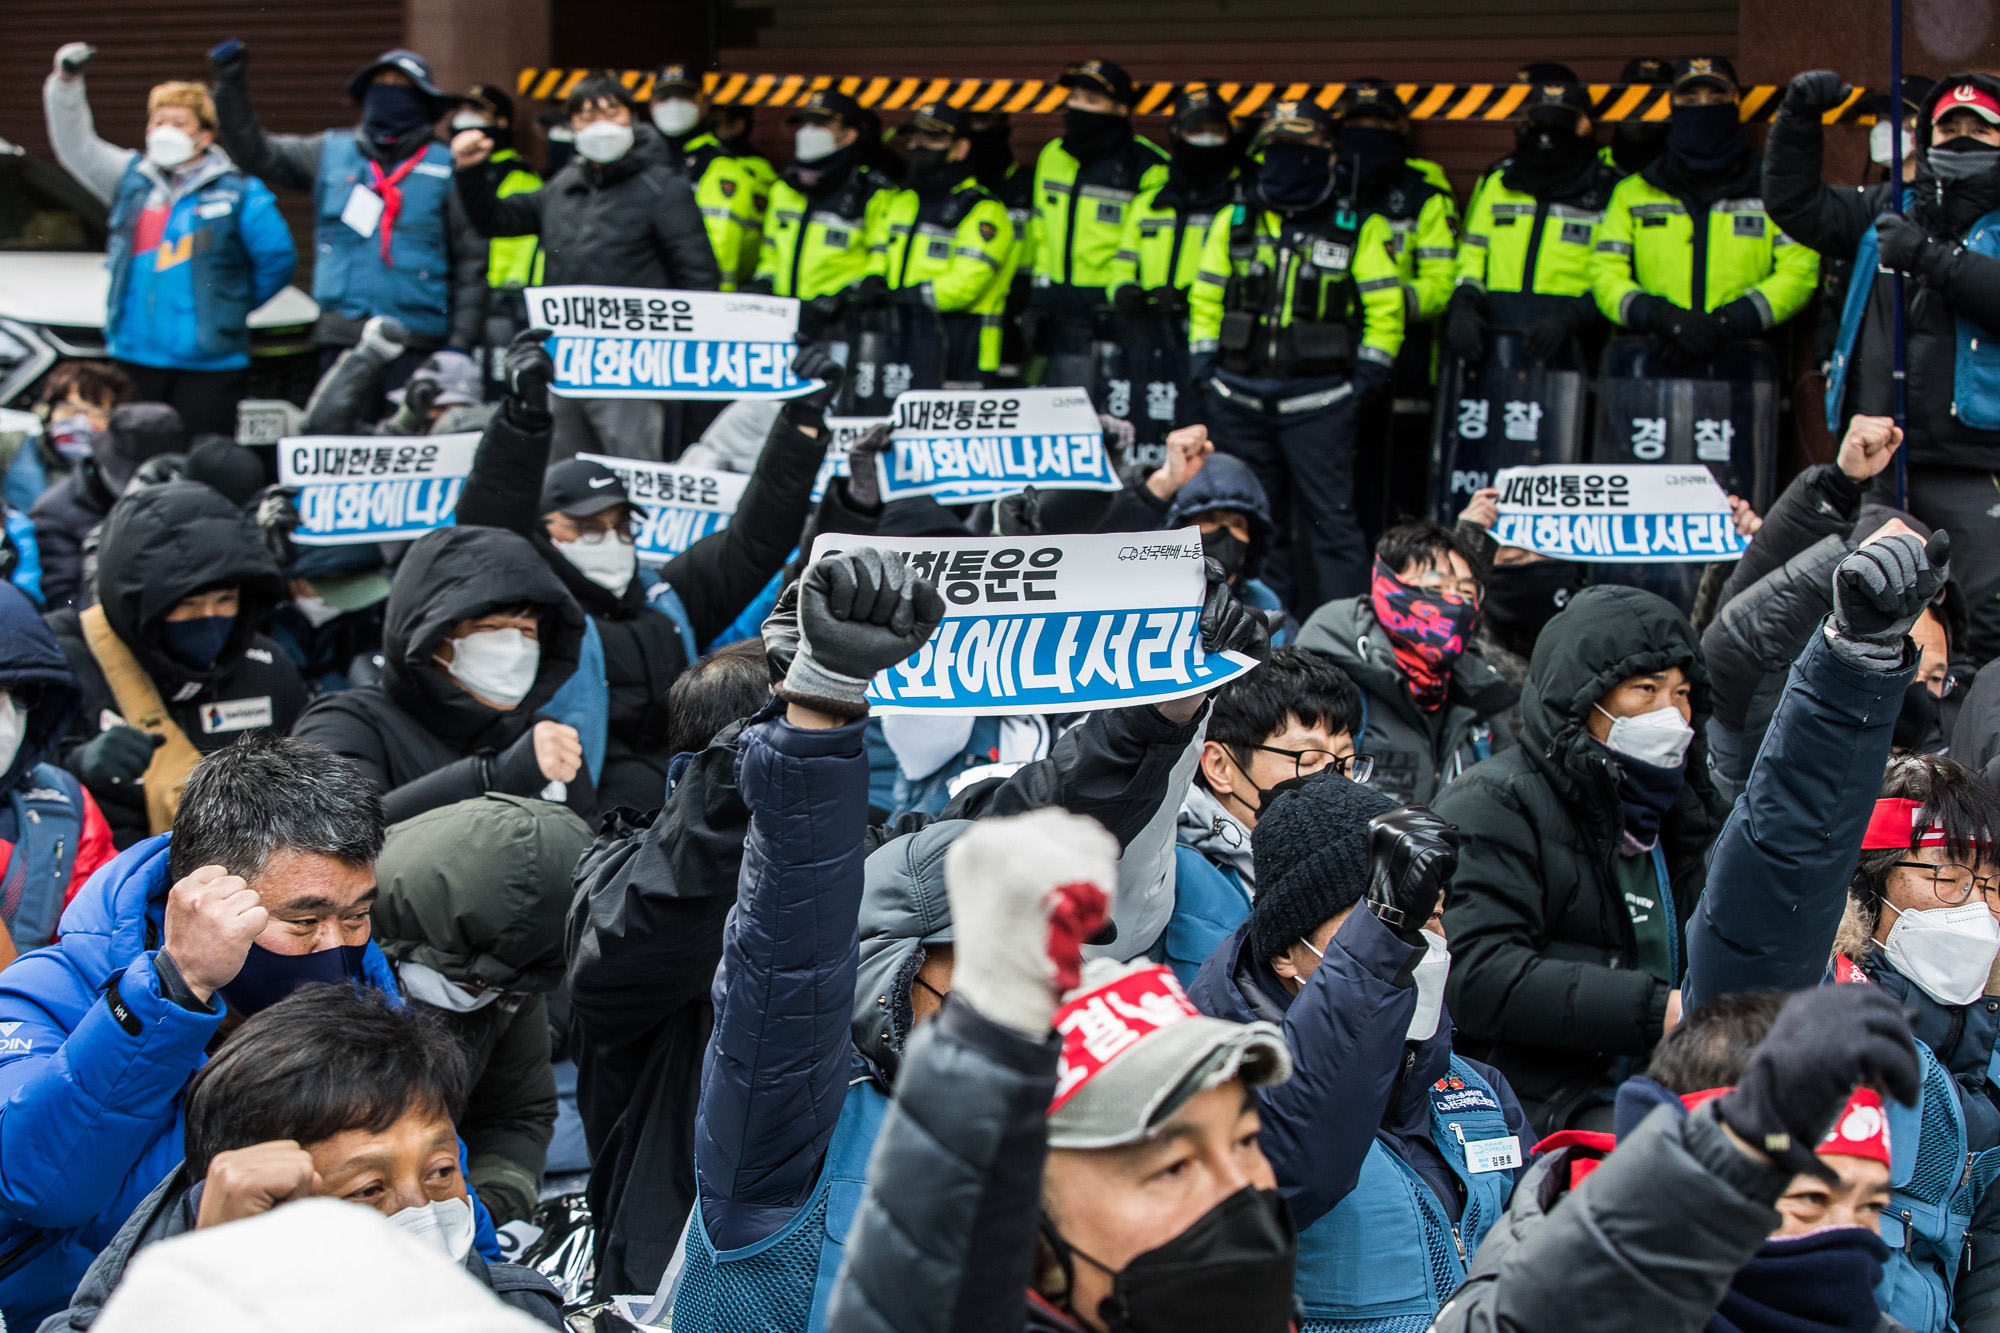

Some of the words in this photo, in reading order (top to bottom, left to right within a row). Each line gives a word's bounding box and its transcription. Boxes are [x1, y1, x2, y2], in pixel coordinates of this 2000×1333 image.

[541, 297, 694, 333] CJ대한통운은
[855, 361, 912, 398] 경찰
[894, 399, 1020, 430] J대한통운은
[1107, 379, 1179, 420] 경찰
[1457, 398, 1543, 442] 경찰
[1630, 417, 1736, 462] 경찰
[292, 445, 439, 476] CJ대한통운은
[1495, 474, 1630, 507] J대한통운은
[1139, 544, 1182, 561] 전국택배
[863, 610, 1213, 700] 화에나서라!
